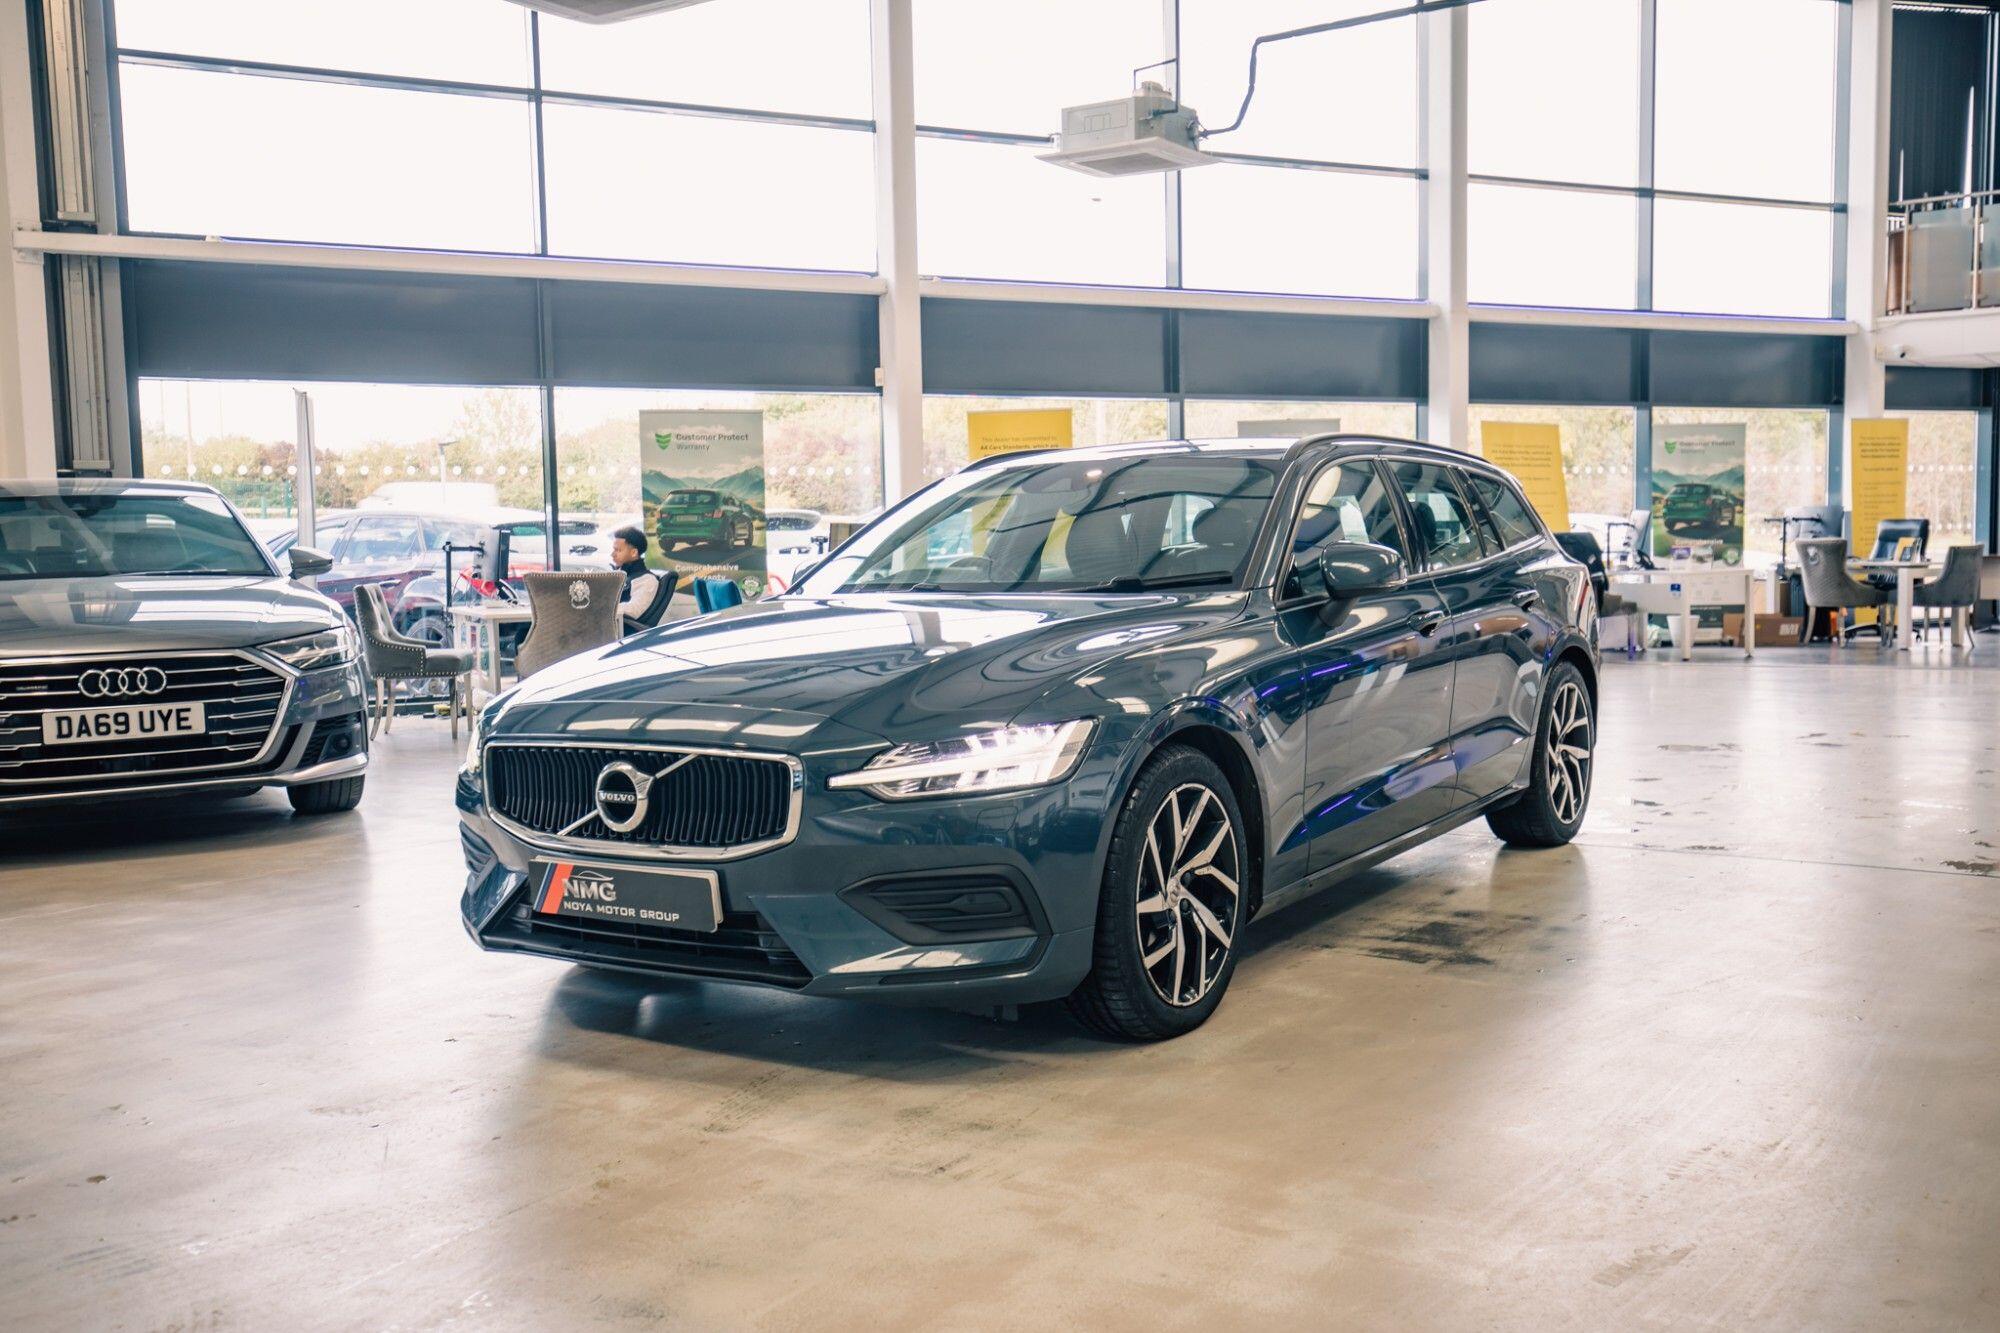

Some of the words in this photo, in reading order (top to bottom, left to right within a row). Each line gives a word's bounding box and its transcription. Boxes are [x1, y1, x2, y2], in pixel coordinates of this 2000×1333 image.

[676, 433, 715, 441] Customer
[718, 433, 749, 441] Protect
[676, 444, 710, 452] Warranty
[675, 563, 739, 572] Comprehensive
[56, 712, 130, 740] DA69
[139, 708, 192, 732] UYE
[599, 790, 635, 802] VOLVO
[562, 877, 617, 901] NMG
[563, 901, 594, 912] NOYA
[596, 905, 637, 917] MOTOR
[640, 909, 680, 922] GROUP
